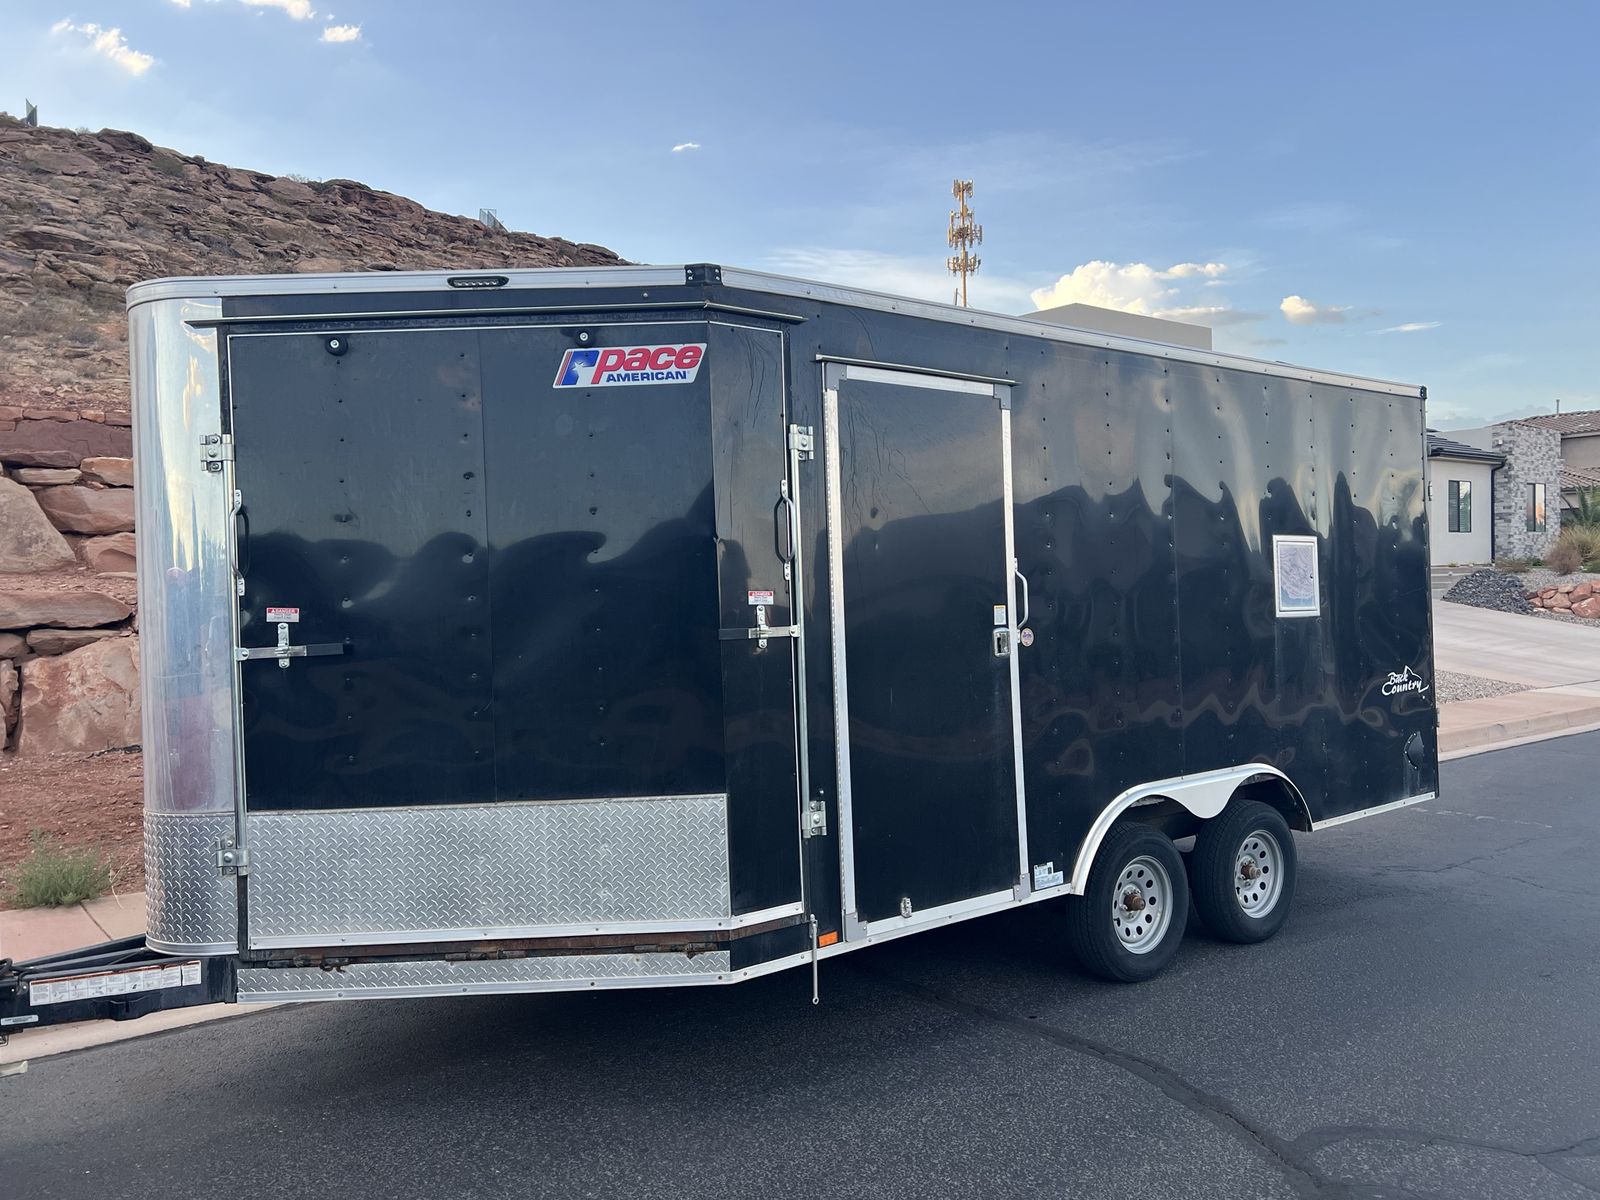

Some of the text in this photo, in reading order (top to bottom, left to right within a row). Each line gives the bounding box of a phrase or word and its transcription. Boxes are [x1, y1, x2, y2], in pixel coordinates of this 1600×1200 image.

[591, 346, 702, 384] pace
[606, 371, 687, 382] AMERICAN
[1382, 680, 1429, 695] Country
